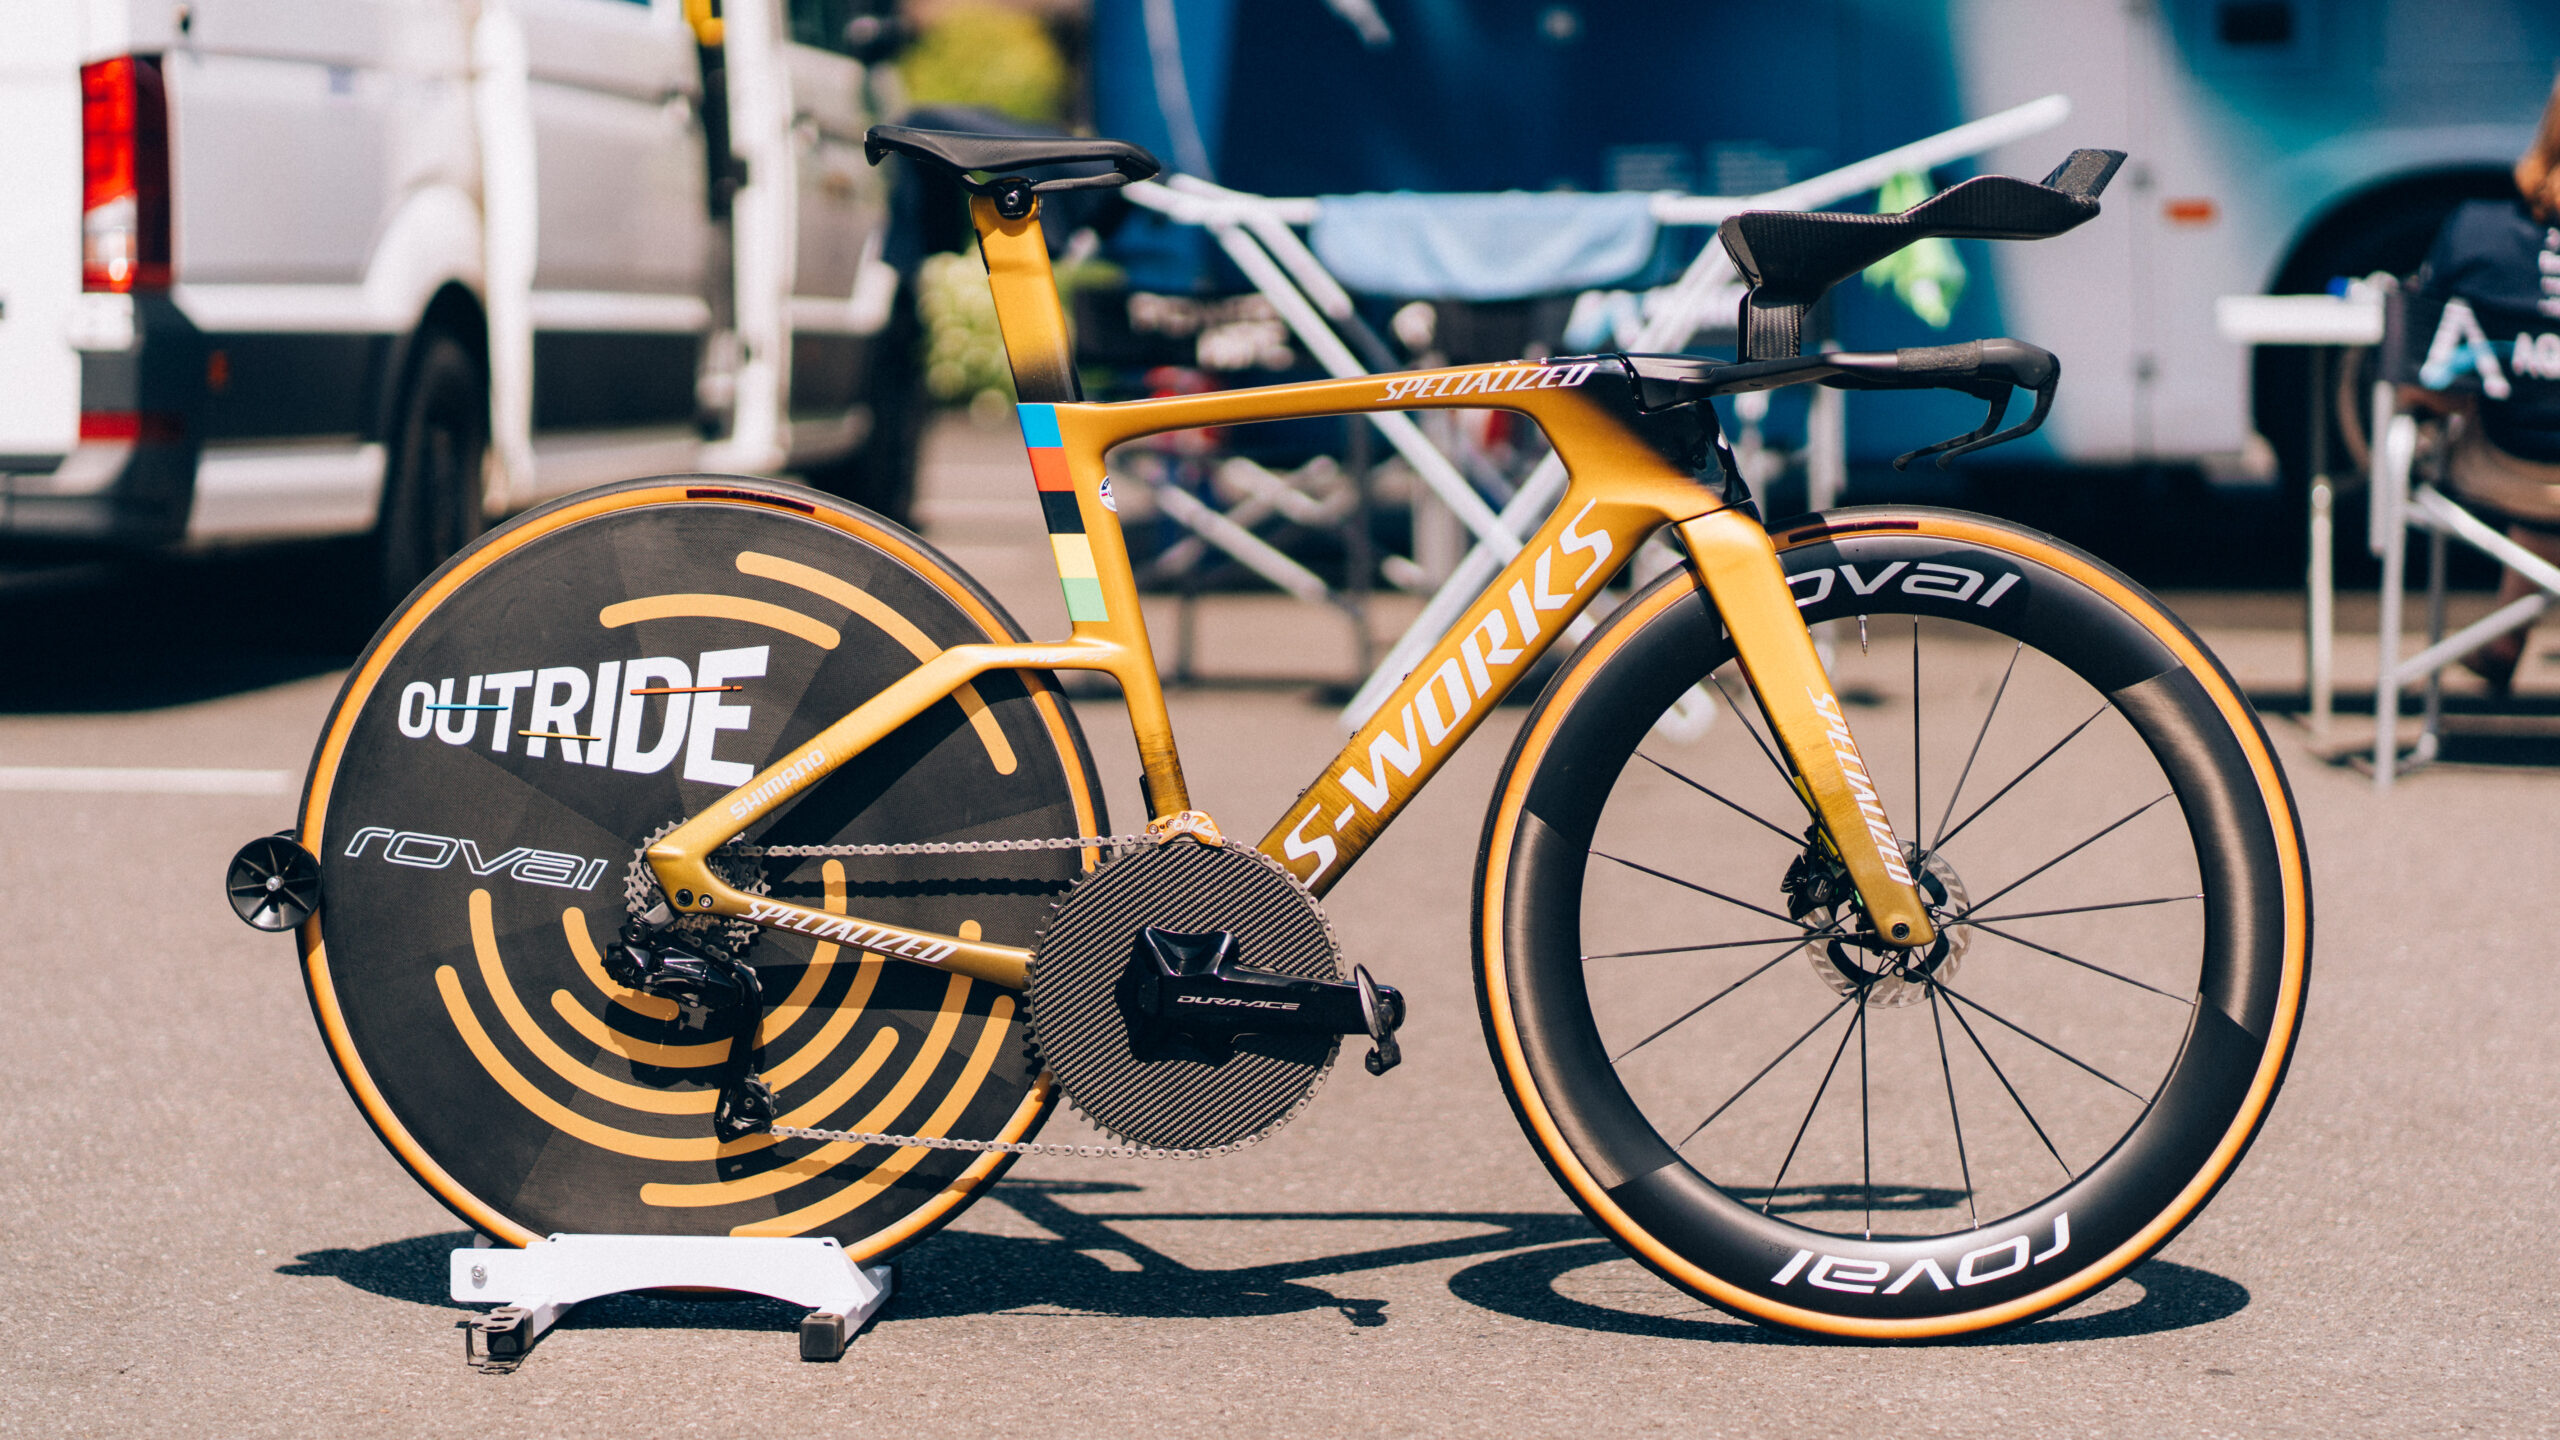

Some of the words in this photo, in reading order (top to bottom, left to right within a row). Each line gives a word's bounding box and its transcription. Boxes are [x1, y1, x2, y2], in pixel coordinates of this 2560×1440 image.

[1376, 362, 1600, 402] SPECIALIZED
[1787, 560, 2023, 608] oval
[397, 645, 770, 787] OUTRIDE
[1283, 498, 1614, 889] S-WORKS
[728, 748, 827, 821] SHIMANO
[1806, 685, 1914, 886] SPECIALIZED
[344, 826, 609, 891] roval
[736, 900, 959, 964] SPECIALIZED
[1176, 995, 1301, 1011] DURA-ACE
[1770, 1211, 2072, 1294] roval
